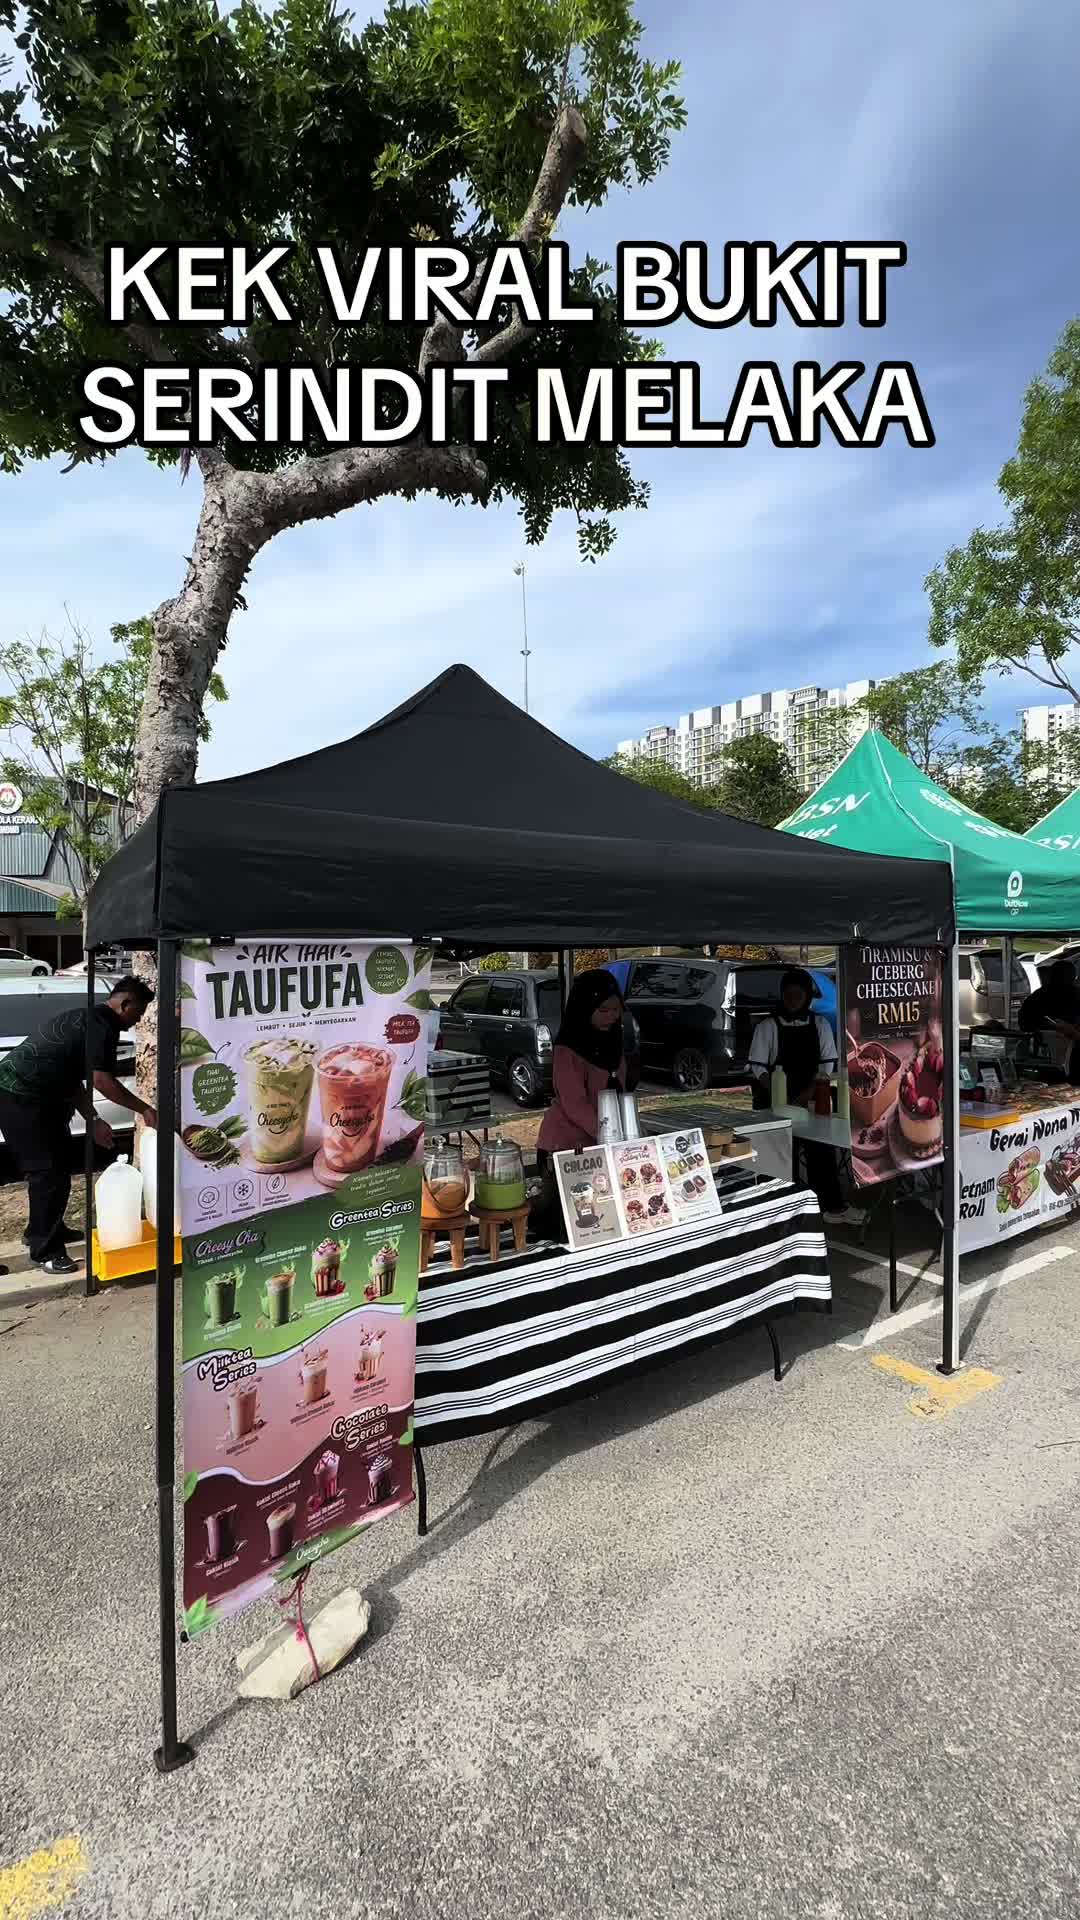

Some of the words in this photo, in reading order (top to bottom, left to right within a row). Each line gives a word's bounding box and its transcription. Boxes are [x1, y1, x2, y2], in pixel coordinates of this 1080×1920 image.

[253, 943, 289, 964] AIR
[295, 943, 337, 962] THAI
[861, 946, 920, 964] TIRAMISU
[871, 964, 924, 981] ICEBERG
[205, 962, 364, 1020] TAUFUFA
[856, 980, 935, 999] CHEESECAKE
[877, 1001, 920, 1025] RM15
[256, 1023, 280, 1032] LEMBUT
[989, 1127, 1029, 1152] Gerai
[1031, 1117, 1068, 1142] Nona
[330, 1211, 379, 1229] Greentea
[381, 1201, 413, 1218] Series
[195, 1239, 235, 1258] Cheesy
[235, 1230, 259, 1247] Cha
[199, 1349, 251, 1379] Milktea
[215, 1365, 255, 1390] Series
[332, 1405, 388, 1438] Chocolate
[347, 1423, 385, 1449] Series
